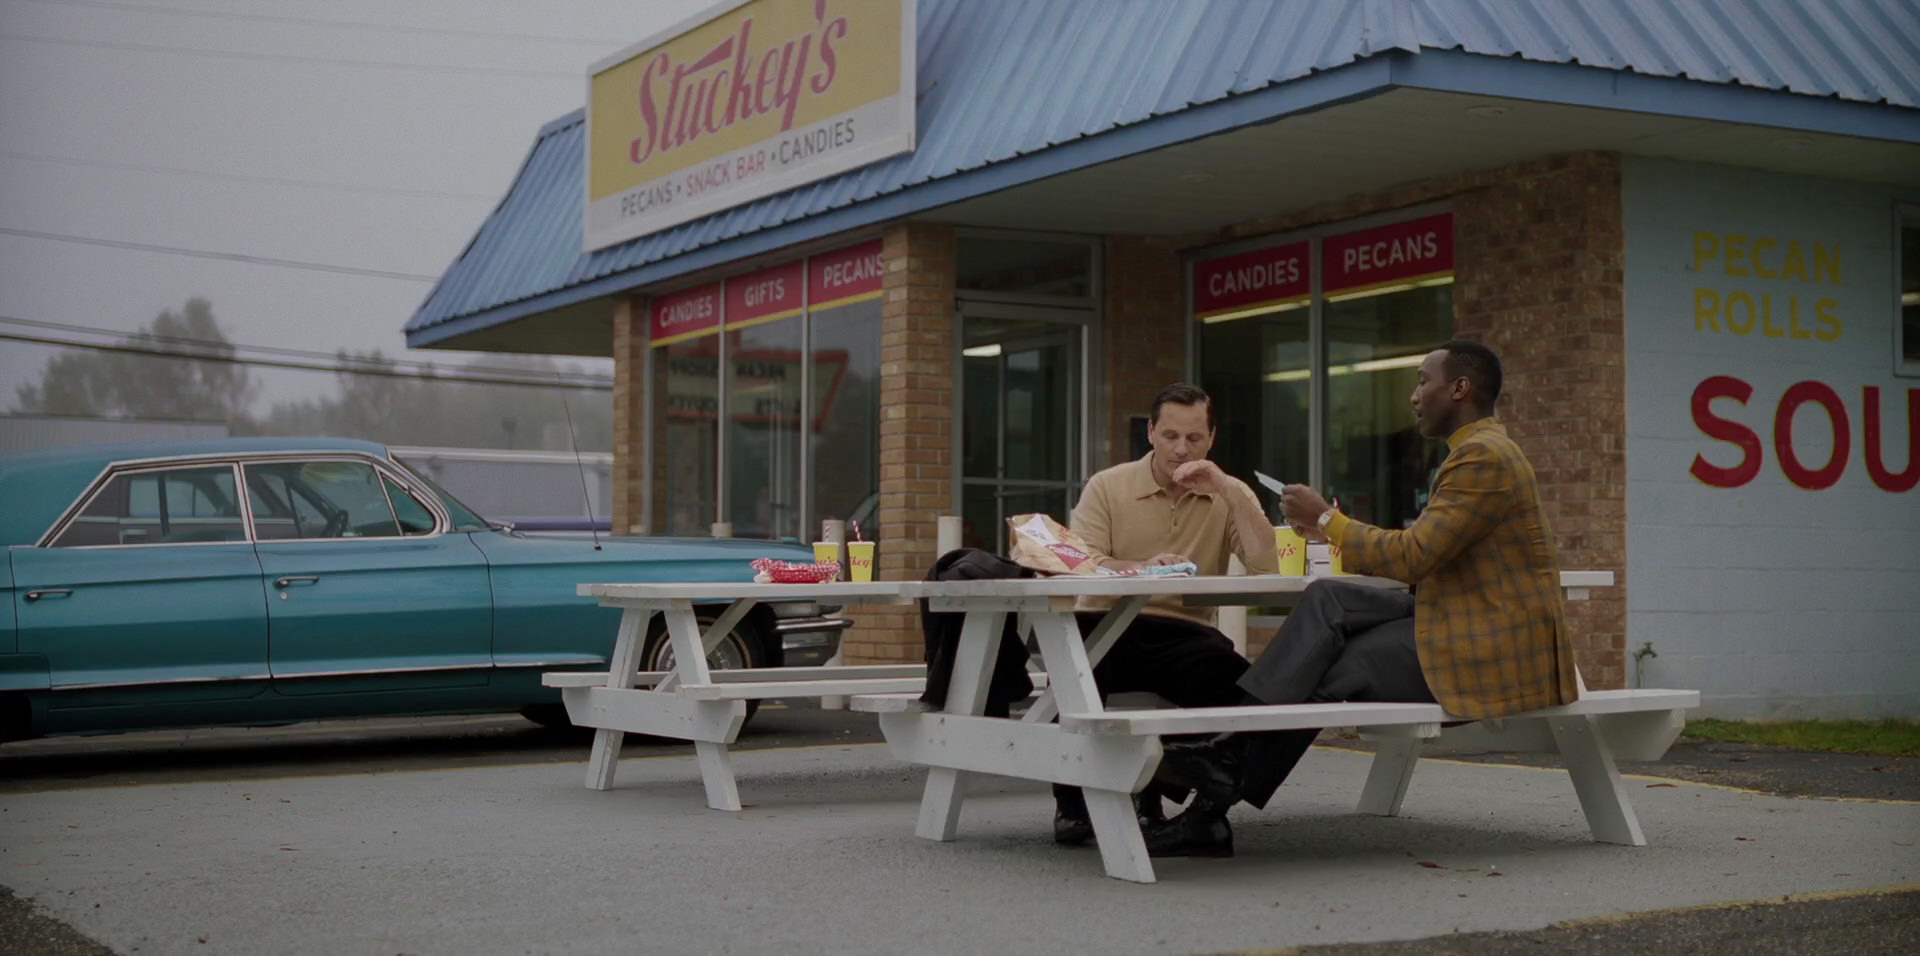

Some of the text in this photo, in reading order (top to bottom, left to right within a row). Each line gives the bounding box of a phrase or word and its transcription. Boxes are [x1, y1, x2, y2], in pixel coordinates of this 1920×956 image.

[629, 0, 849, 165] Stuckey's
[620, 118, 855, 218] PECANS SNACK BAR CANDIES
[823, 253, 884, 288] PECANS
[1209, 257, 1300, 297] CANDIES
[1343, 231, 1438, 275] PECANS
[1693, 231, 1842, 286] PECAN
[660, 295, 713, 328] CANDIES
[744, 278, 785, 307] GIFTS
[1693, 287, 1843, 342] ROLLS
[1689, 375, 1920, 494] SOU
